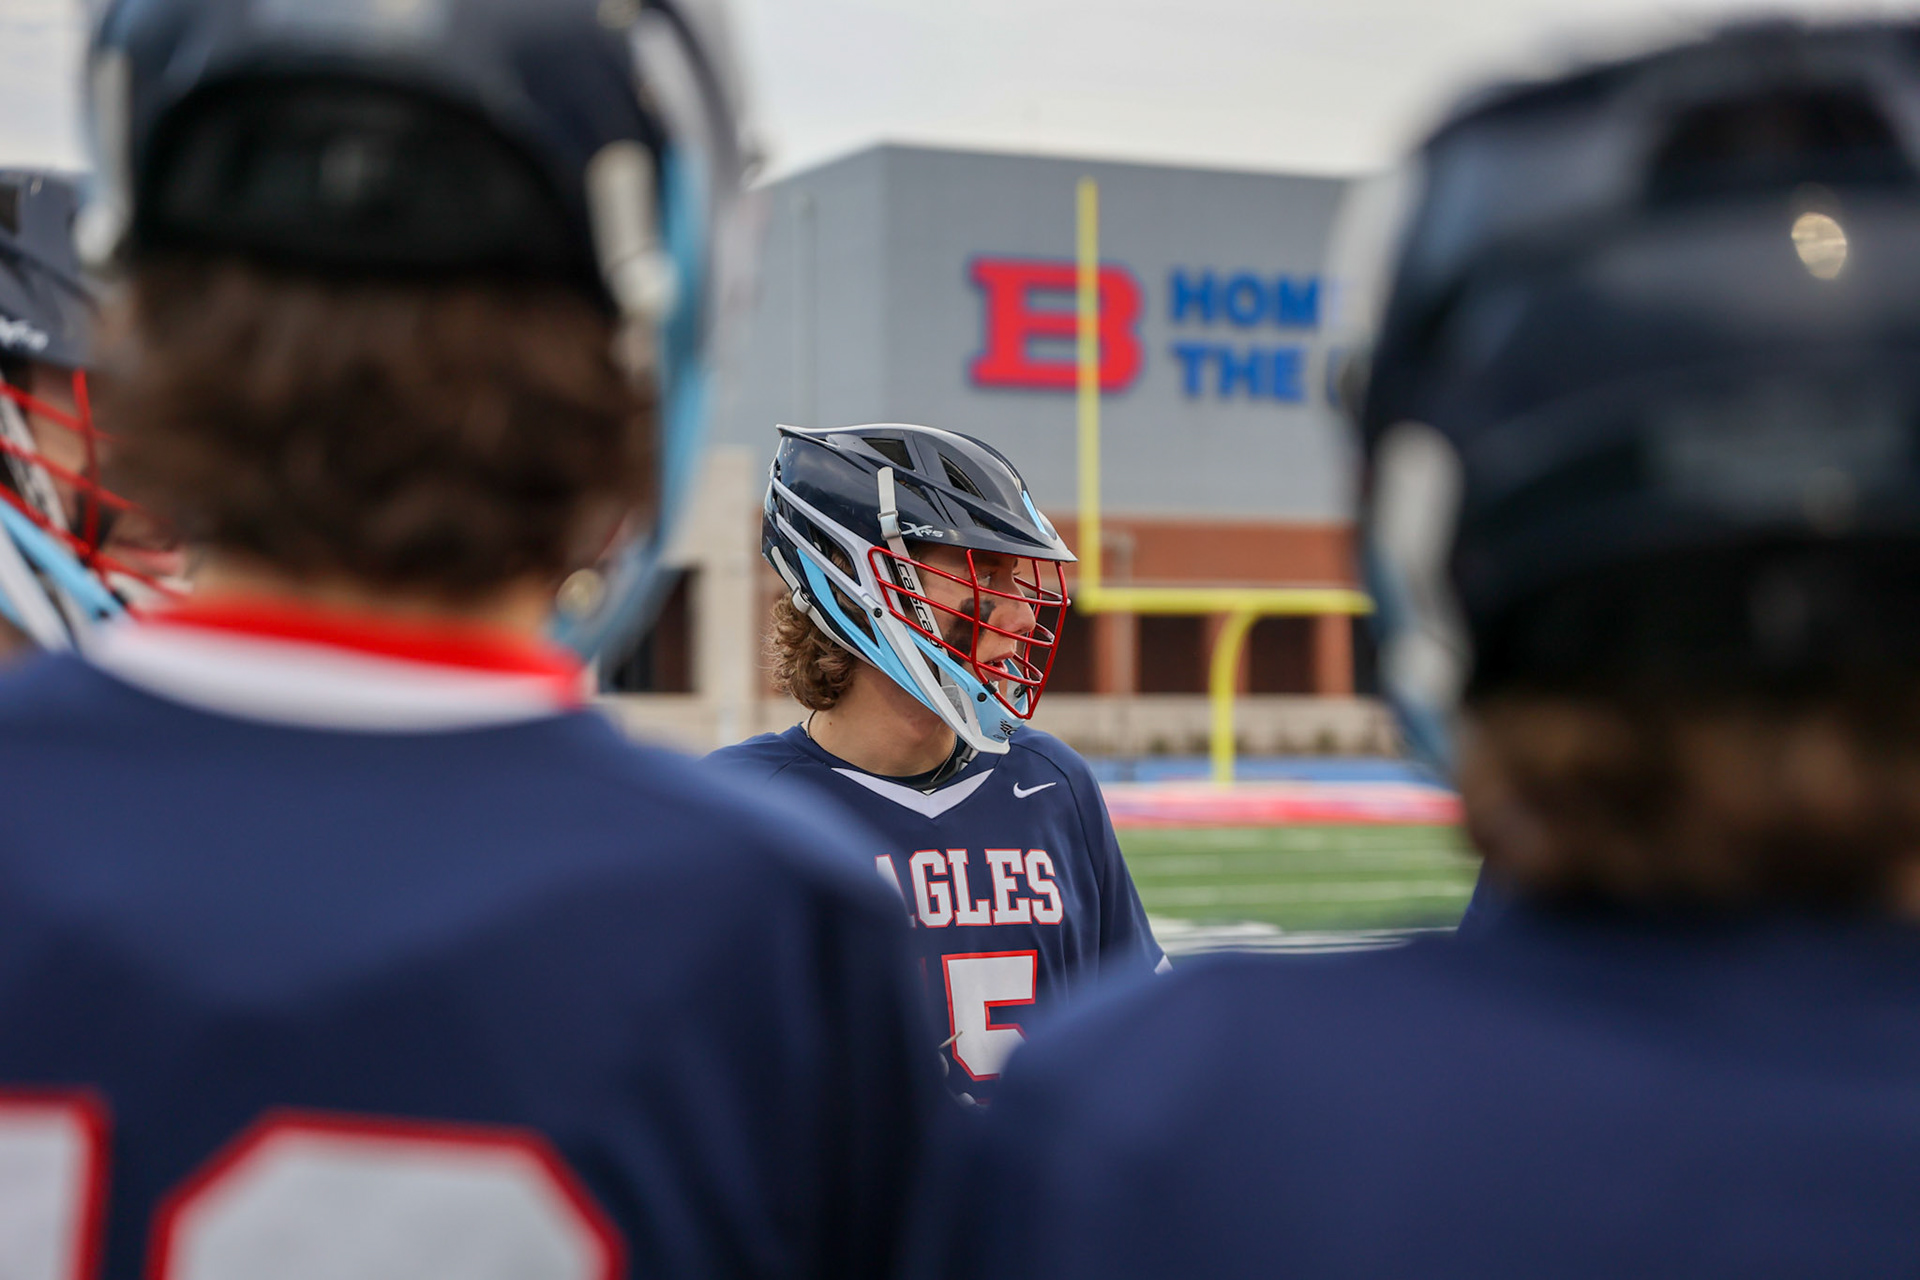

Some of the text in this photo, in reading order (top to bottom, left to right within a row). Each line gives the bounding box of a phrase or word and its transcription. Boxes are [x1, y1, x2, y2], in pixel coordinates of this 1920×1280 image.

[970, 256, 1144, 392] B
[1170, 268, 1323, 329] HOM
[1172, 341, 1308, 404] THE
[941, 949, 1038, 1083] 5
